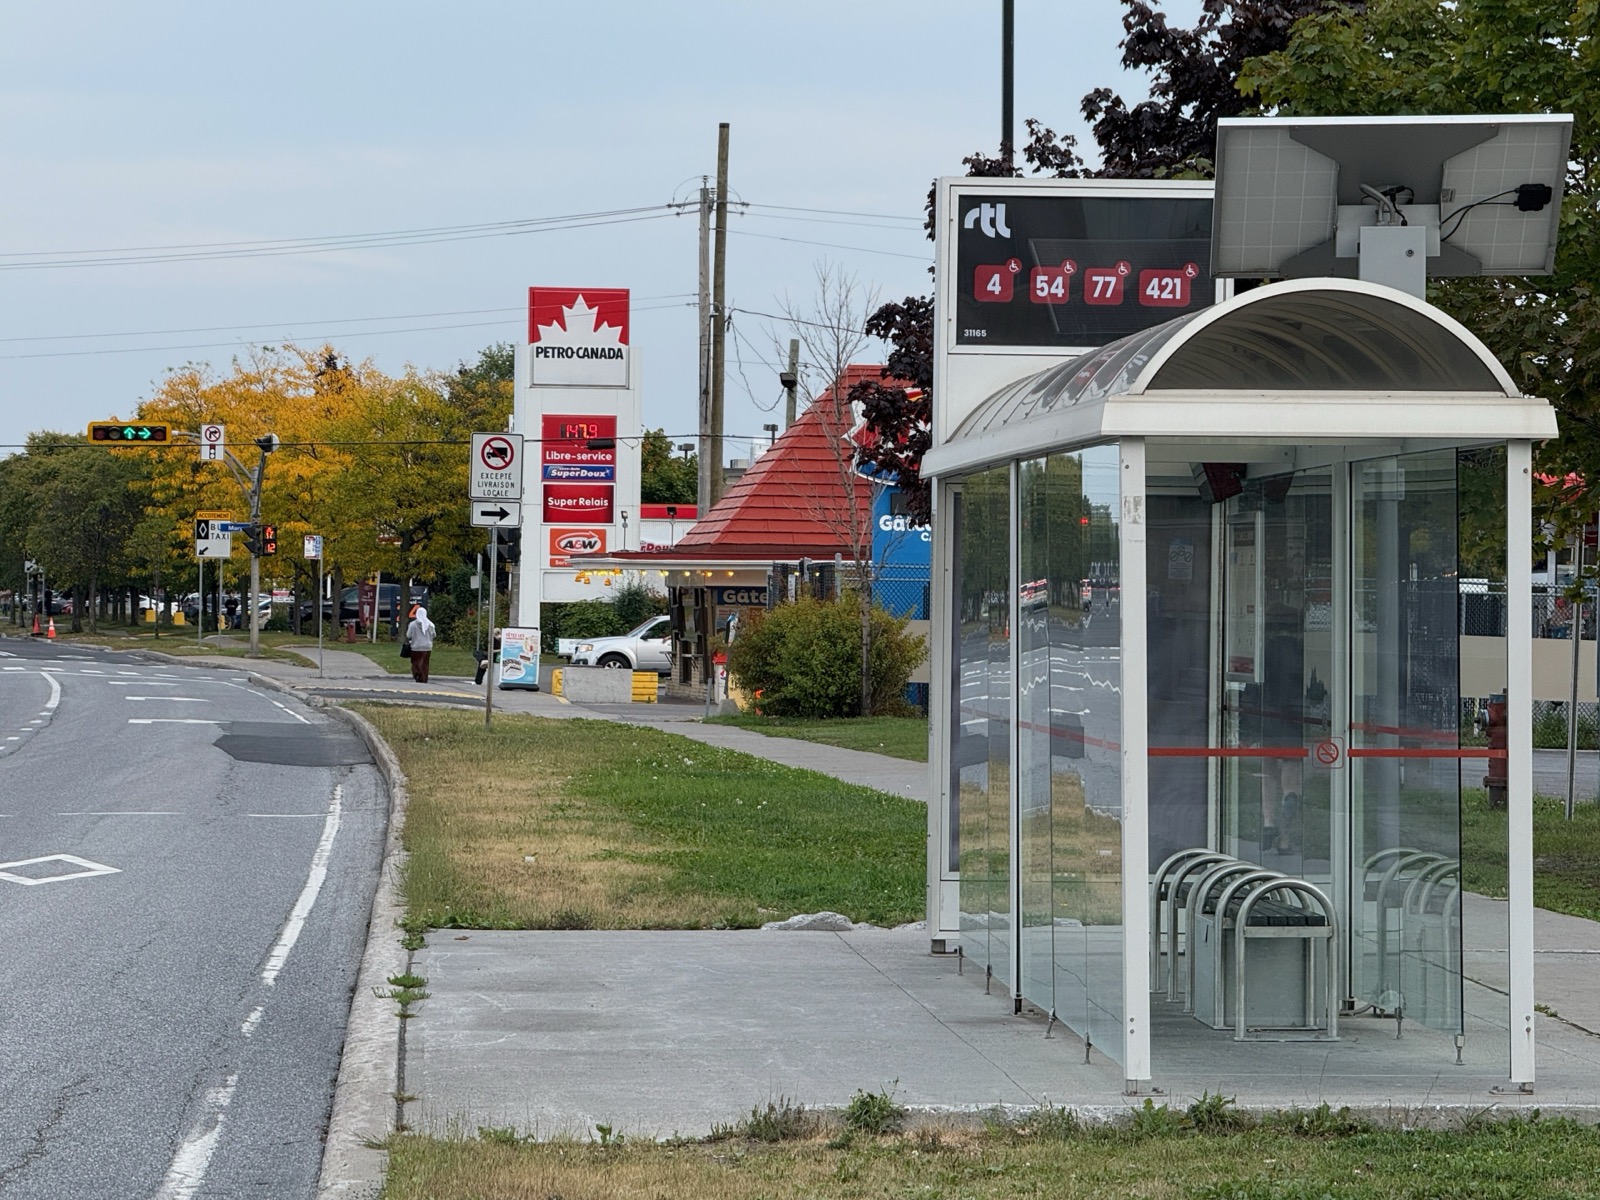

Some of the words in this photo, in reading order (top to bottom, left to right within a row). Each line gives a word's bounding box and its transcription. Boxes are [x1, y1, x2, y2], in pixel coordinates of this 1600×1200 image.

[964, 202, 1011, 239] rtl
[986, 273, 1002, 295] 4
[1036, 275, 1065, 298] 54
[1092, 276, 1117, 298] 77
[1145, 277, 1182, 300] 421
[963, 328, 987, 338] 31165
[546, 451, 612, 461] Libre-service
[480, 472, 512, 480] EXCEPTÉ
[551, 469, 606, 478] SuperDoux
[477, 481, 515, 489] LIVRAISON
[483, 489, 509, 497] LOCALE
[547, 497, 578, 507] Super
[579, 497, 609, 506] Relais
[267, 543, 276, 553] 12
[562, 539, 598, 550] A&W
